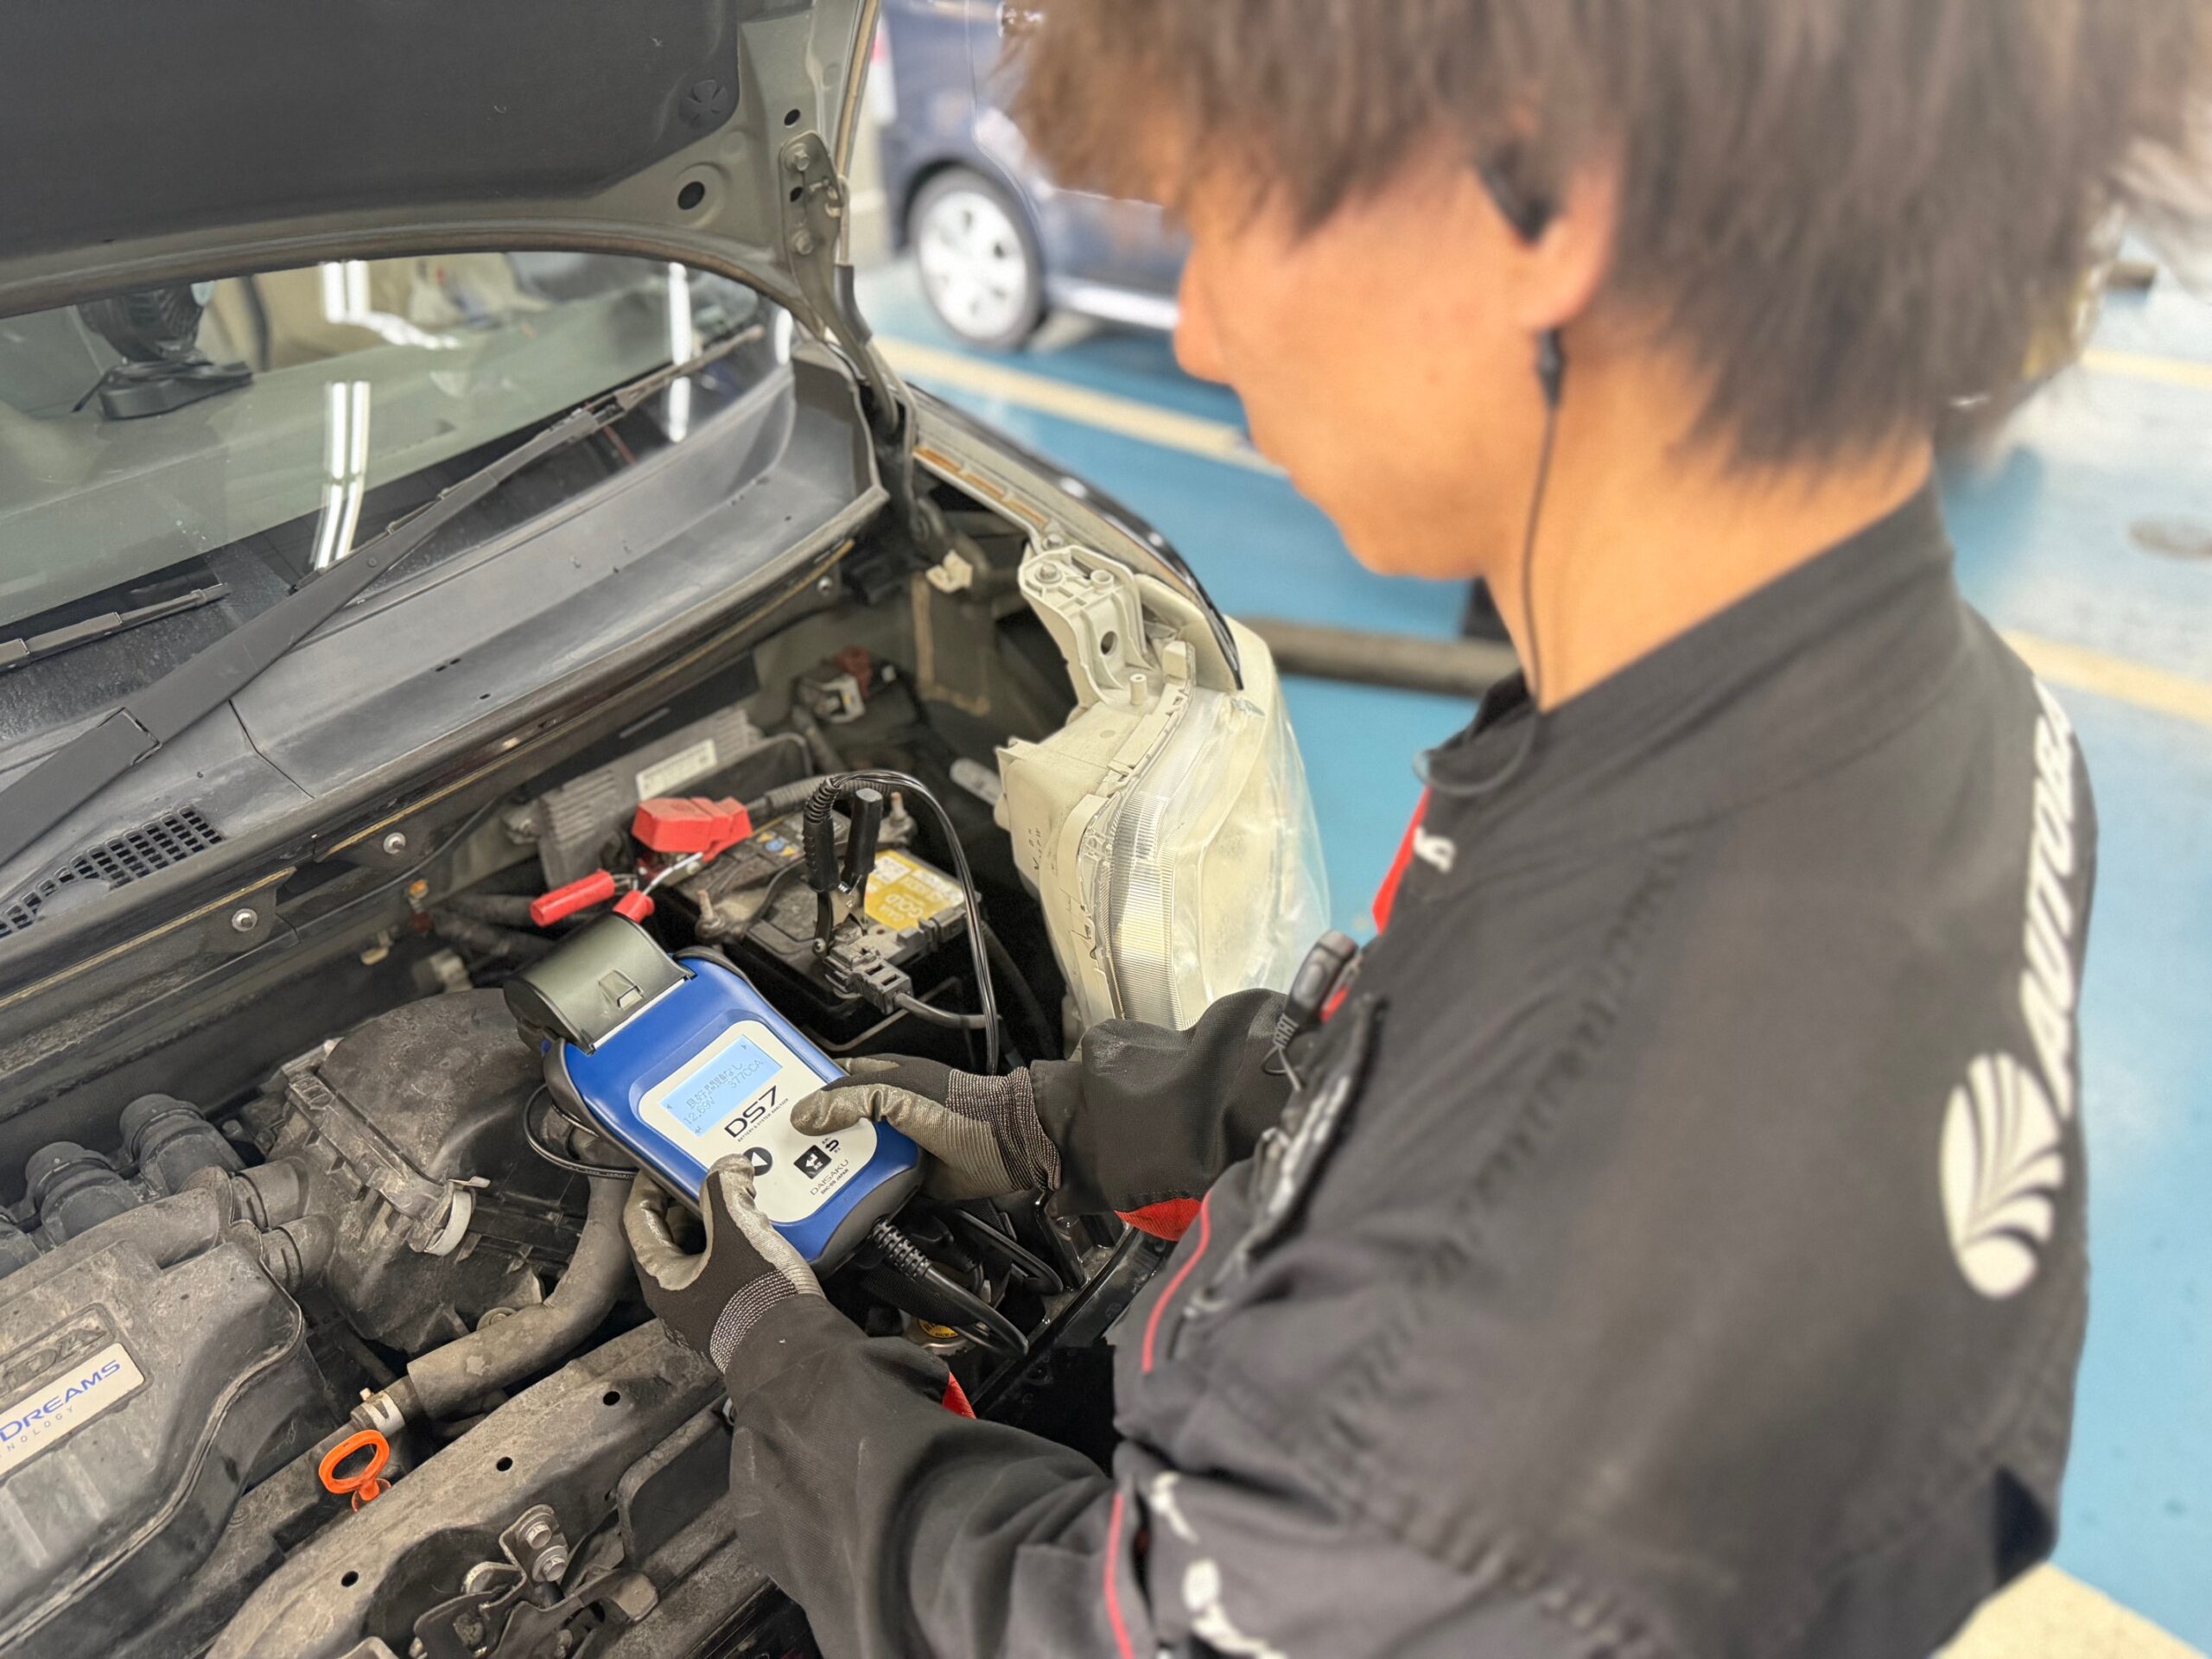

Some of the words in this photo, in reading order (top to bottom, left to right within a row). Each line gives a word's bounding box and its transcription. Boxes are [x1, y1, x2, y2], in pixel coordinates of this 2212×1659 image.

[683, 1096, 715, 1125] 12.69V
[727, 1059, 764, 1089] 377CCA
[724, 1085, 777, 1138] DS7
[737, 1128, 754, 1142] BATTERY
[810, 1159, 849, 1196] DAISAKU
[837, 1168, 849, 1180] JAPAN
[0, 1359, 121, 1442] DREAMS
[0, 1405, 73, 1456] NOLOGY
